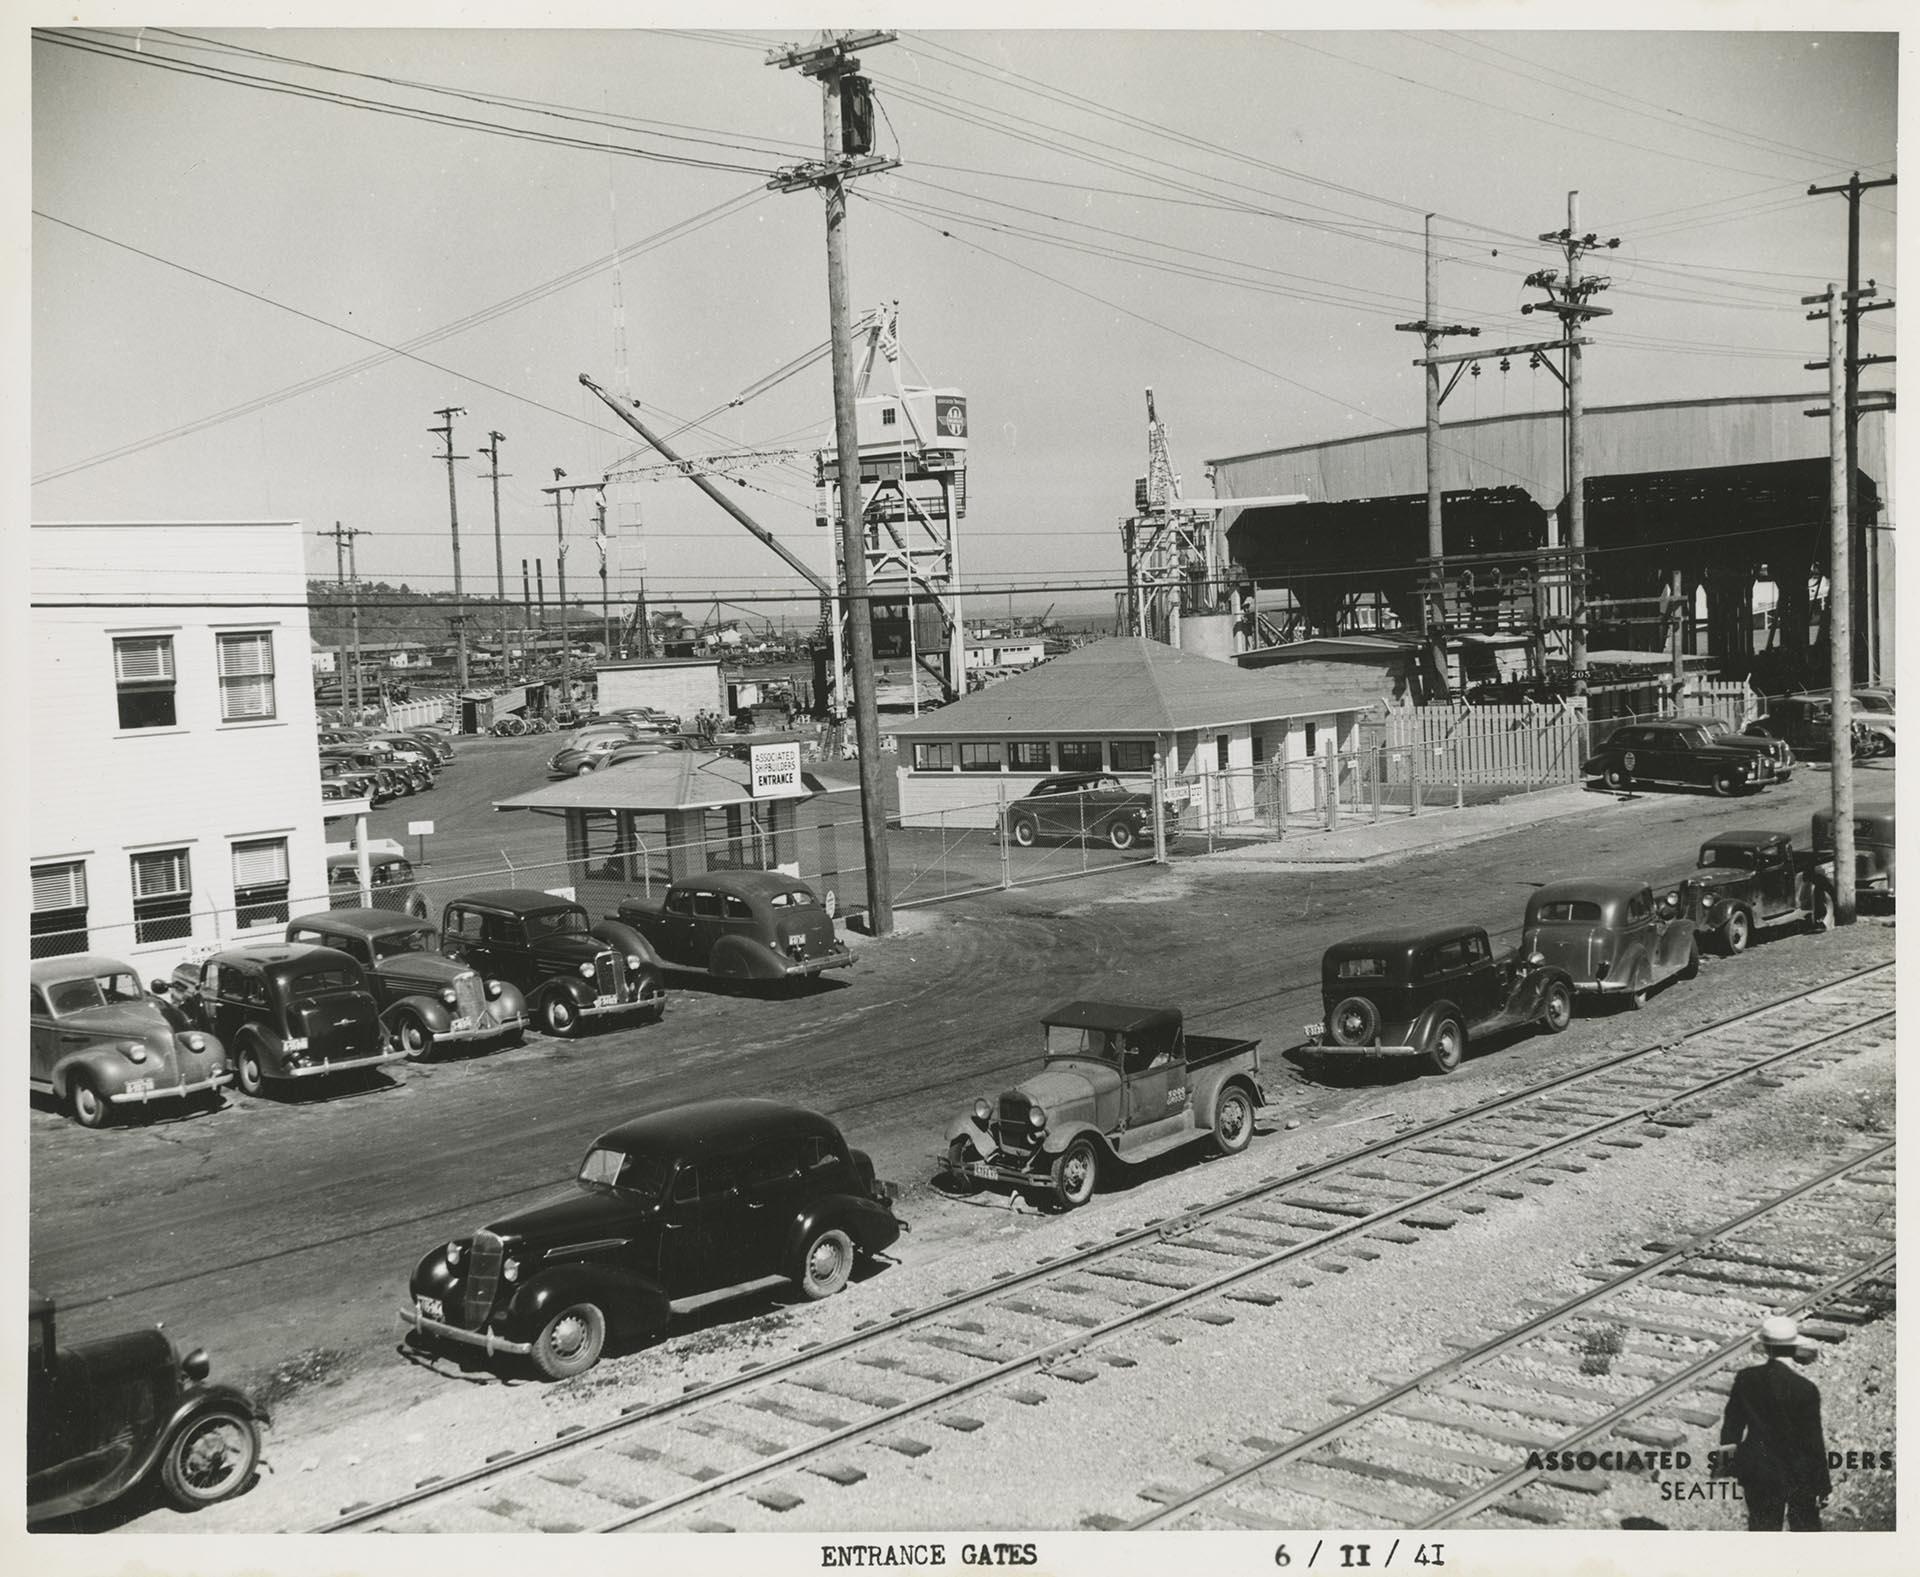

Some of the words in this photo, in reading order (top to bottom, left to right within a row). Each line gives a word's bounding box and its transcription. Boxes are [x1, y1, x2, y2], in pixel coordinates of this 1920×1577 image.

[755, 751, 795, 762] ASSOCIATED
[755, 761, 796, 773] SHIPBUILDERS
[759, 773, 793, 786] ENTRANCE
